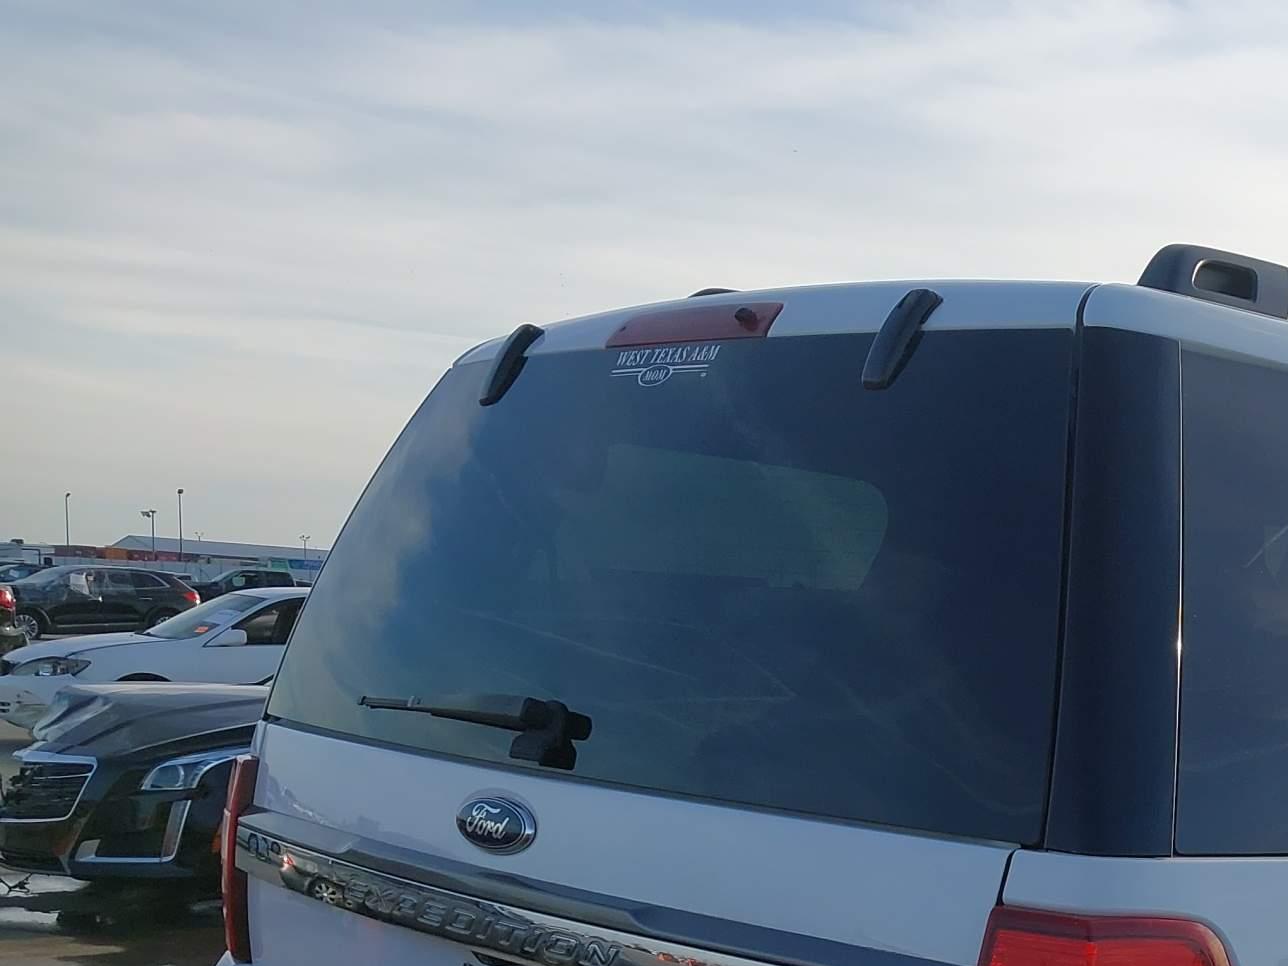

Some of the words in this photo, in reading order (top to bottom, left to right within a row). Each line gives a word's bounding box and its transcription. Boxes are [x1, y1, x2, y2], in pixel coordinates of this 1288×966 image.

[616, 349, 652, 367] WEST
[650, 346, 691, 365] TEXAS
[688, 344, 721, 362] A&M
[466, 803, 509, 839] Ford
